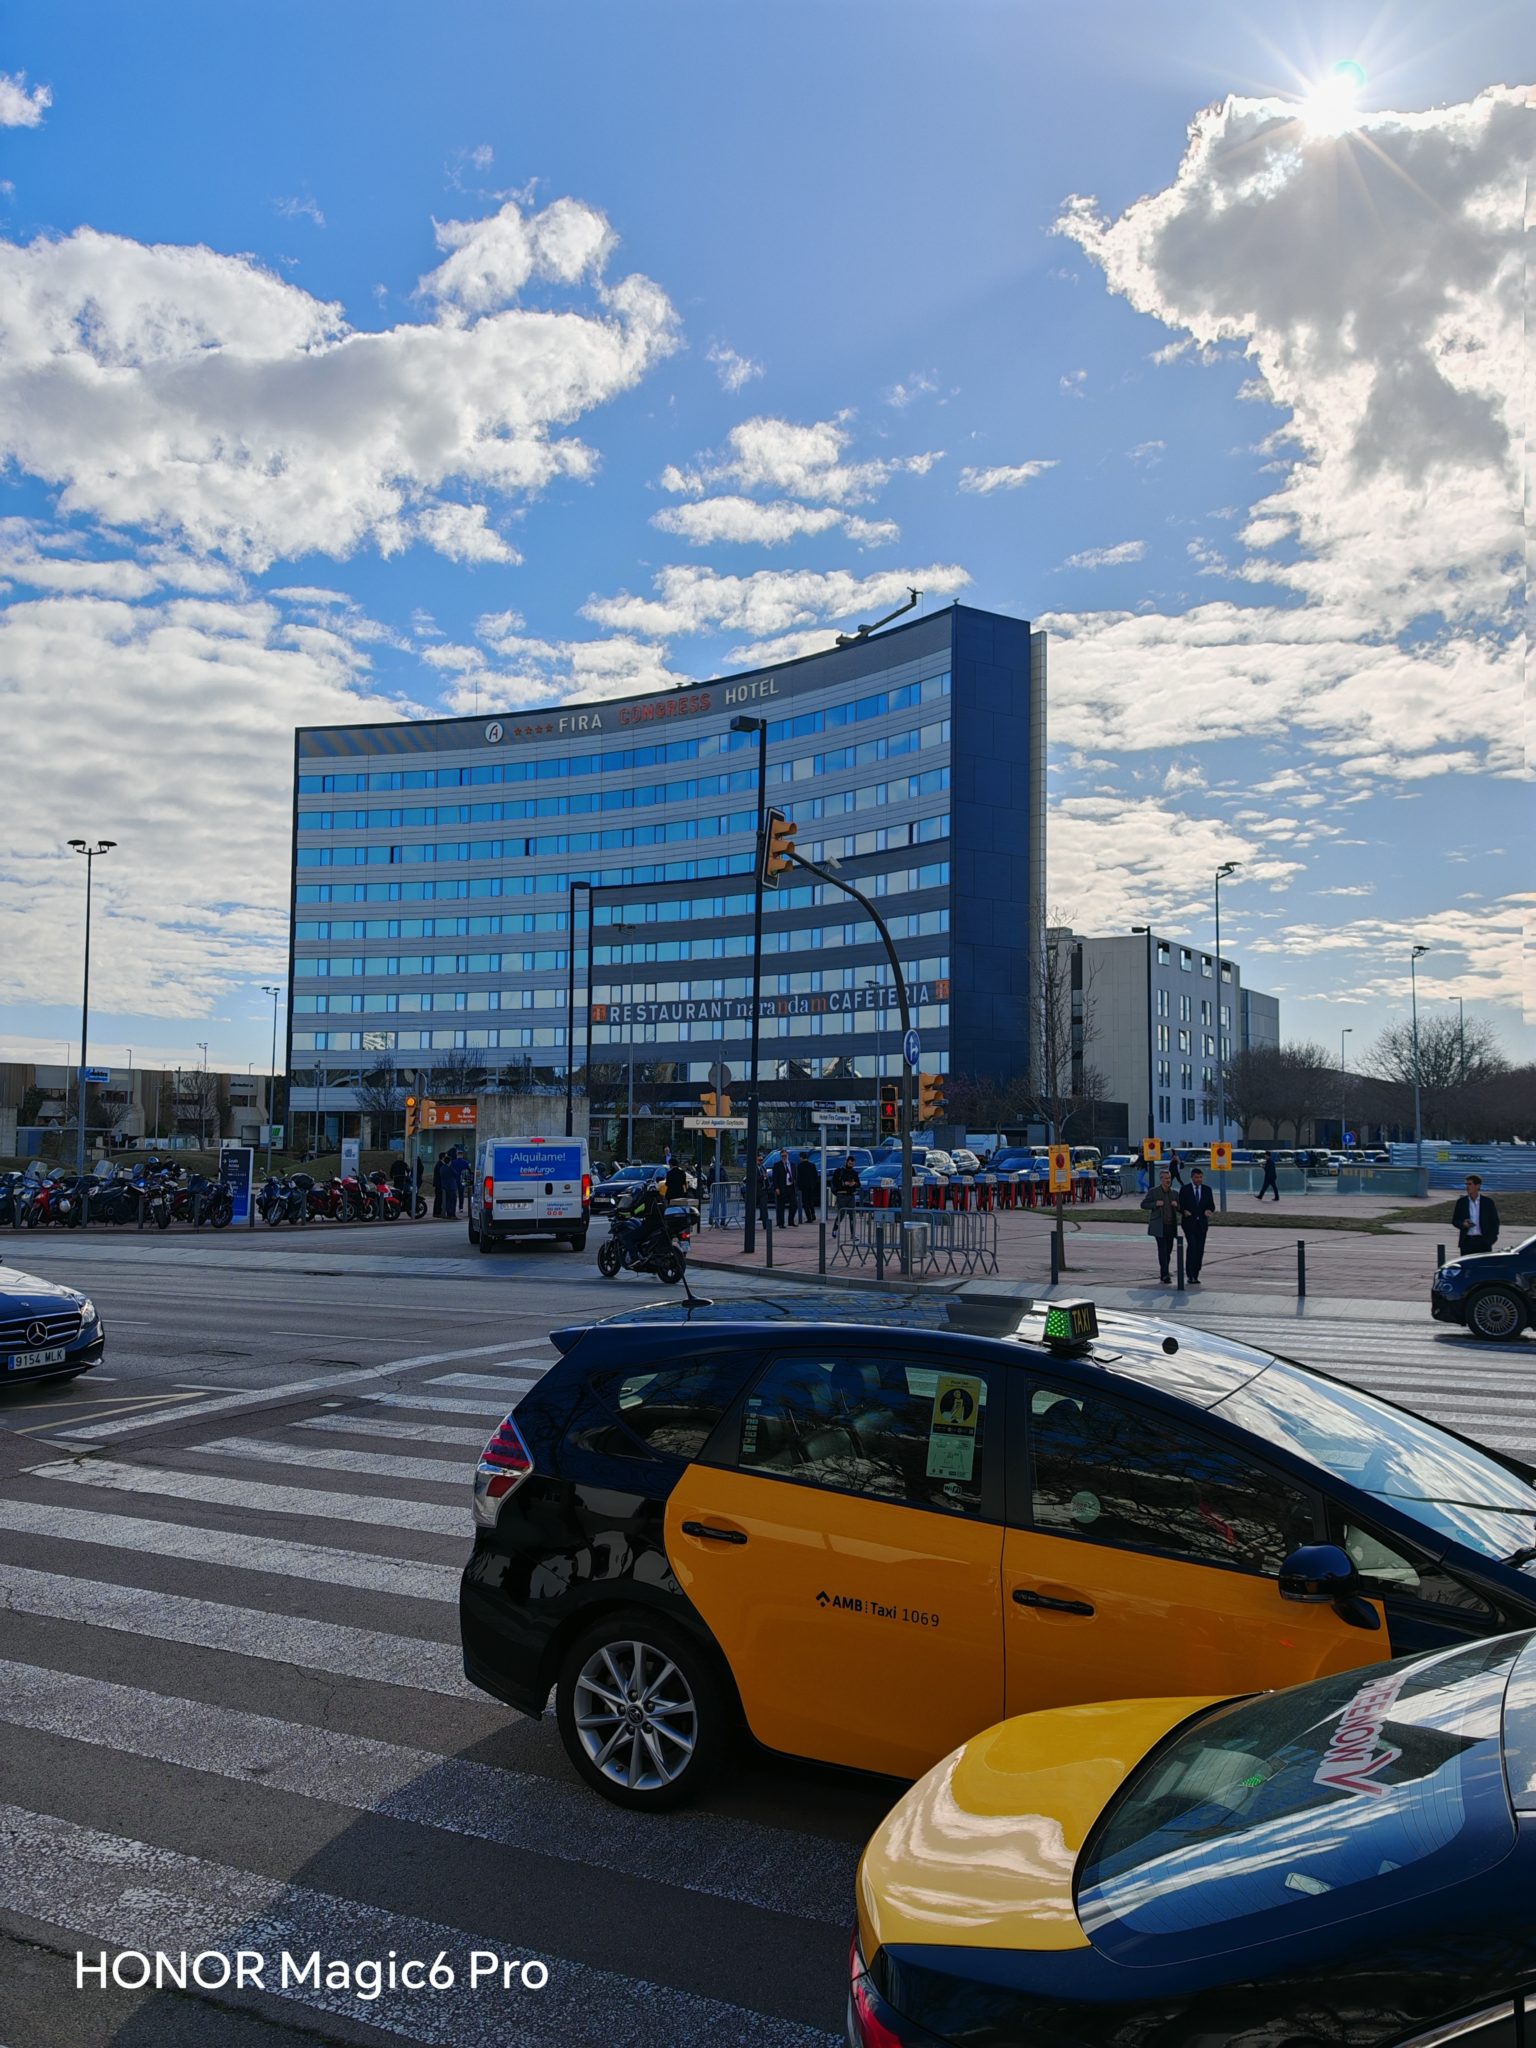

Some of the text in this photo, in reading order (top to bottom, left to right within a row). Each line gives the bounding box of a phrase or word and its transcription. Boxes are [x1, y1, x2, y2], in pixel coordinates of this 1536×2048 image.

[559, 678, 779, 733] FIRA CONGRESS HOTEL
[610, 1001, 733, 1022] RESTAURANT
[829, 979, 929, 1011] CAFETERIA
[520, 1166, 556, 1175] telefurgo
[1072, 1308, 1091, 1334] TAXI
[16, 1349, 63, 1367] 9154 MLK
[832, 1595, 940, 1627] AMB Taxi 1069
